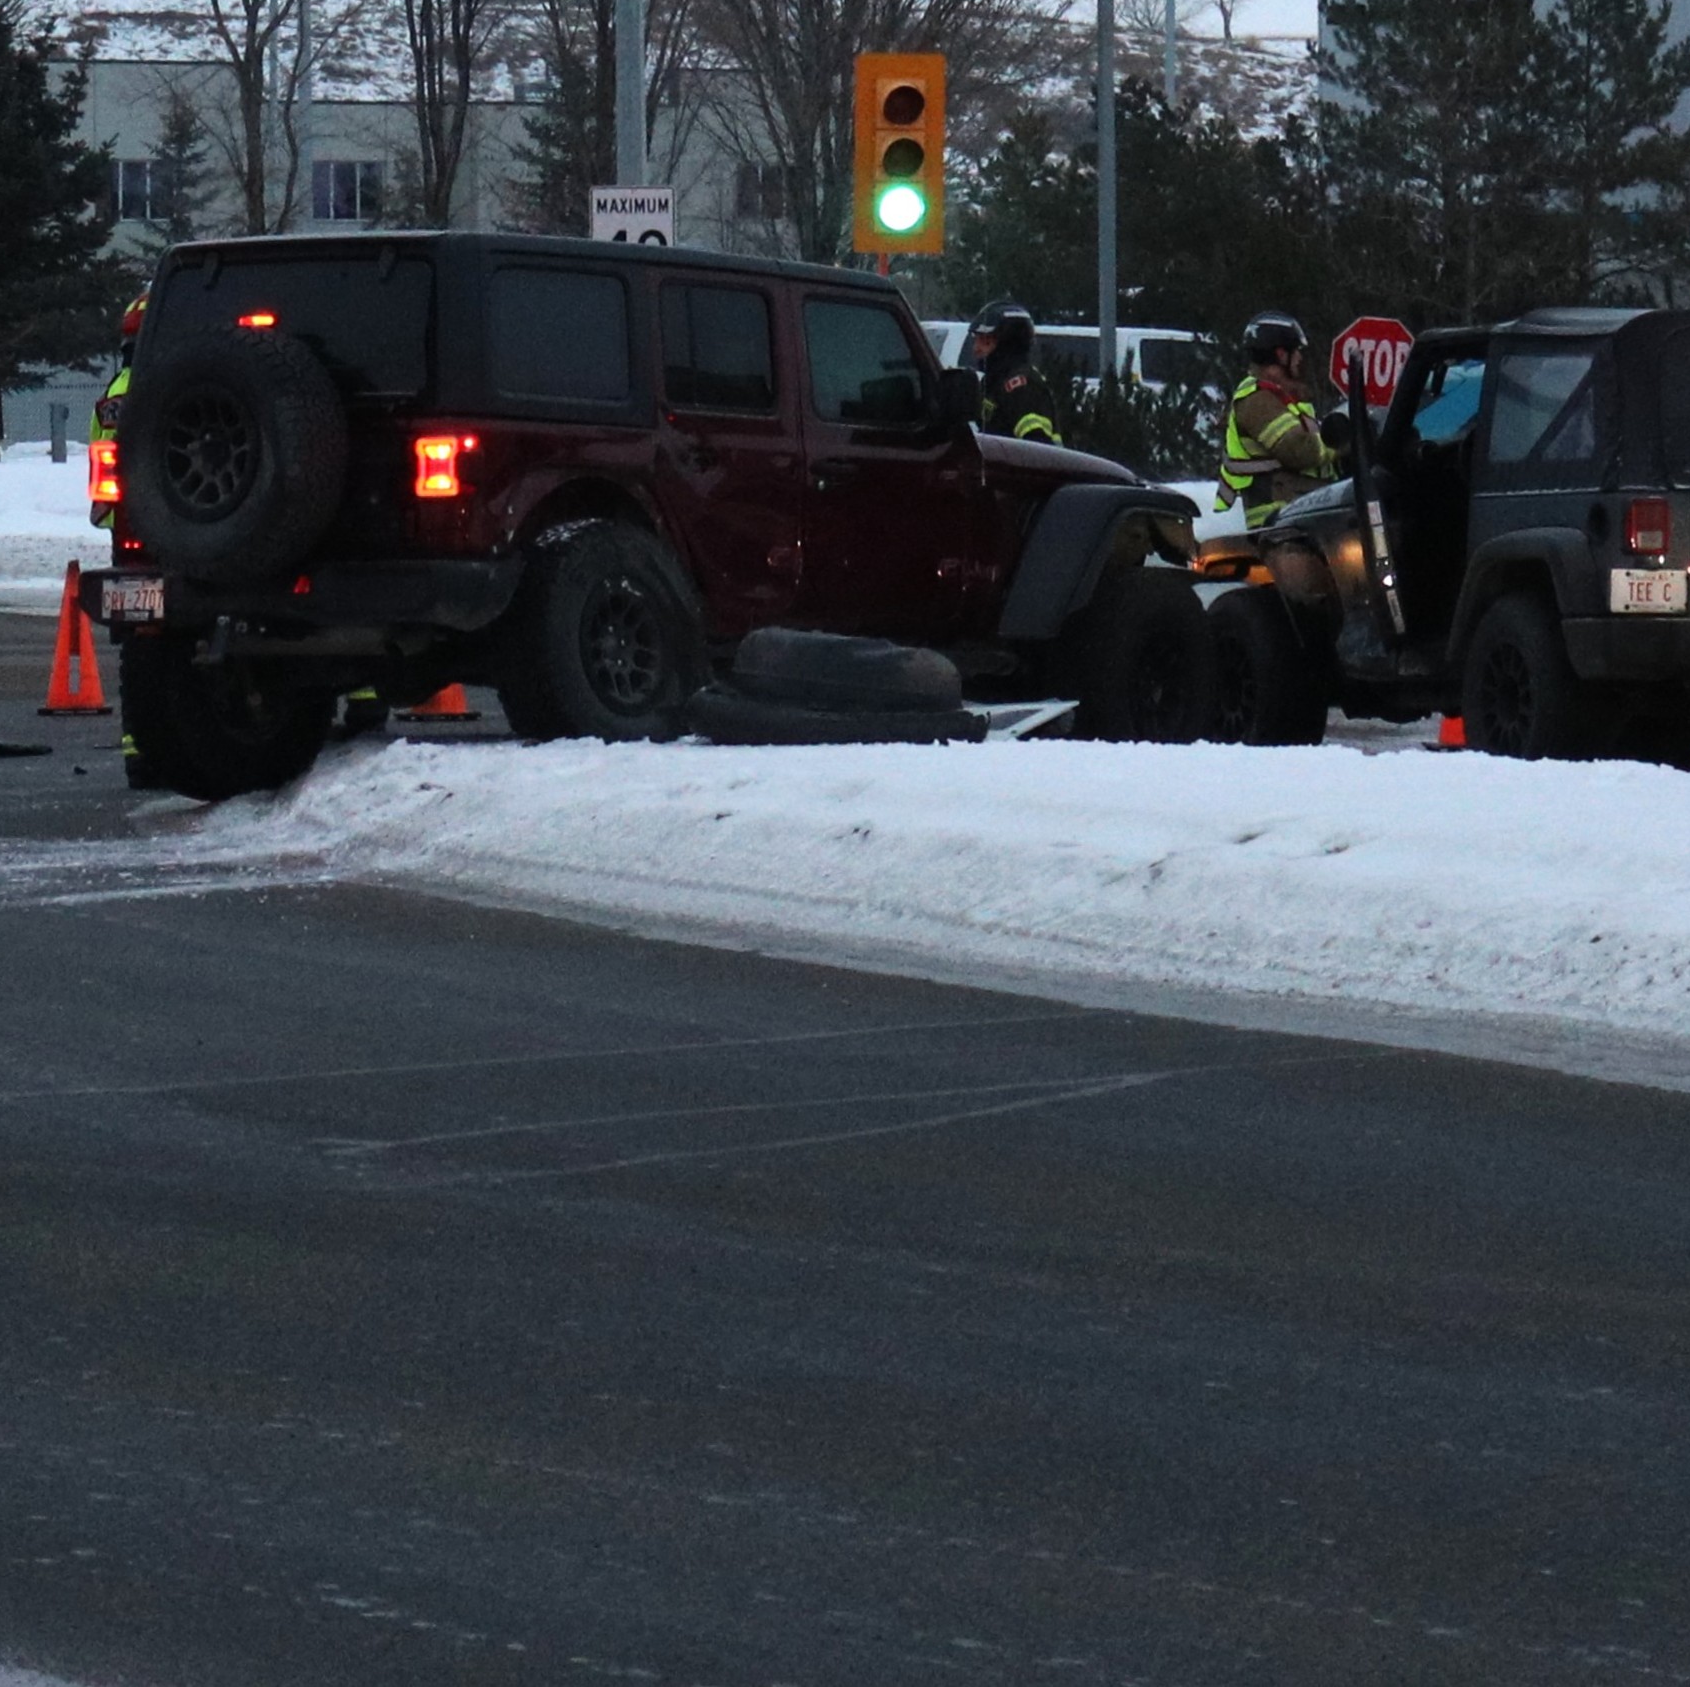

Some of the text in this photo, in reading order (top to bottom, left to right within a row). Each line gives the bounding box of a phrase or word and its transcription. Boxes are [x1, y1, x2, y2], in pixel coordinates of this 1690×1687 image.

[596, 198, 669, 213] MAXIMUM
[1341, 337, 1410, 387] STOP
[1628, 581, 1672, 602] TEE C
